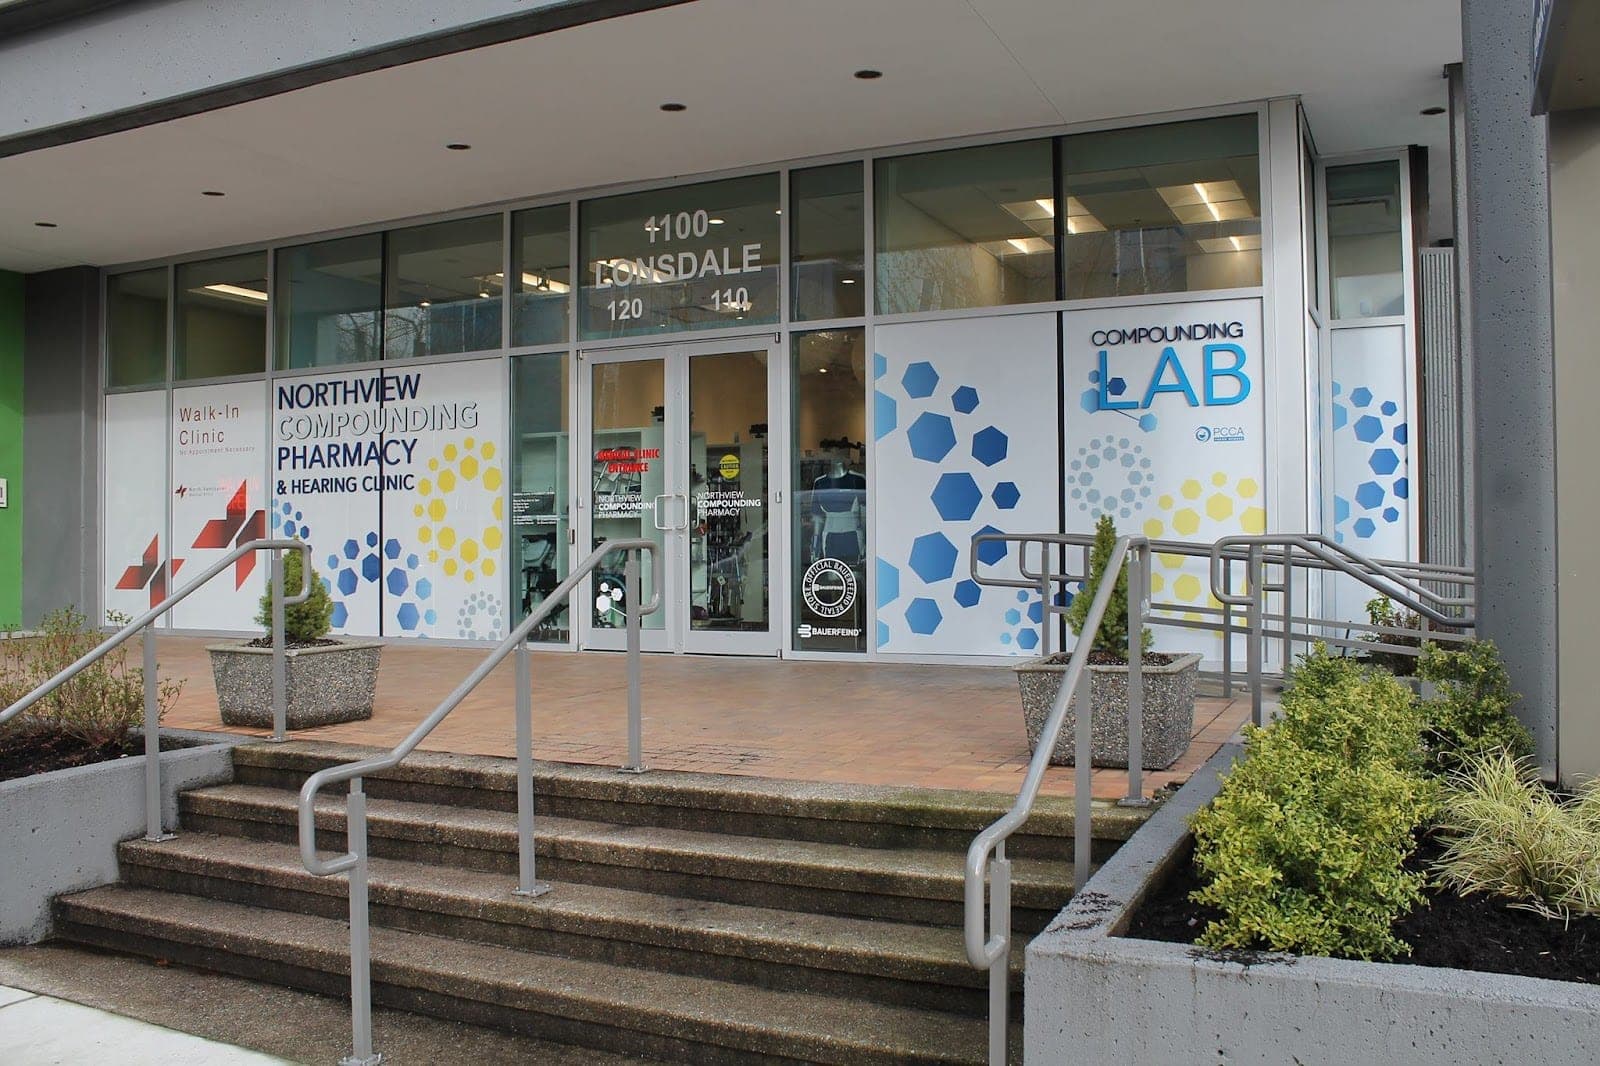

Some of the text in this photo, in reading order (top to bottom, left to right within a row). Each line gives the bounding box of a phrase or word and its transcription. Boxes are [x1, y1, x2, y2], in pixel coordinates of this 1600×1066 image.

[645, 209, 709, 243] 1100
[595, 243, 762, 289] LONSDALE
[607, 287, 748, 321] 120 110
[1092, 322, 1244, 347] COMPOUNDING
[1098, 343, 1252, 410] LAB
[278, 373, 421, 410] NORTHVIEW
[179, 404, 239, 422] Walk-In
[280, 402, 479, 441] COMPOUNDING
[179, 428, 225, 445] Clinic
[1213, 426, 1245, 436] PCCA
[277, 438, 418, 471] PHARMACY
[276, 479, 287, 495] &
[291, 477, 357, 494] HEARING
[362, 473, 415, 491] CLINIC
[697, 491, 745, 500] NORTHVIEW
[598, 494, 642, 503] NORTHVIEW
[697, 499, 762, 508] COMPOUNDING
[697, 508, 741, 517] PHARMACY
[804, 561, 854, 615] OFFICIAL BAUERFEIND RETAIL STORE
